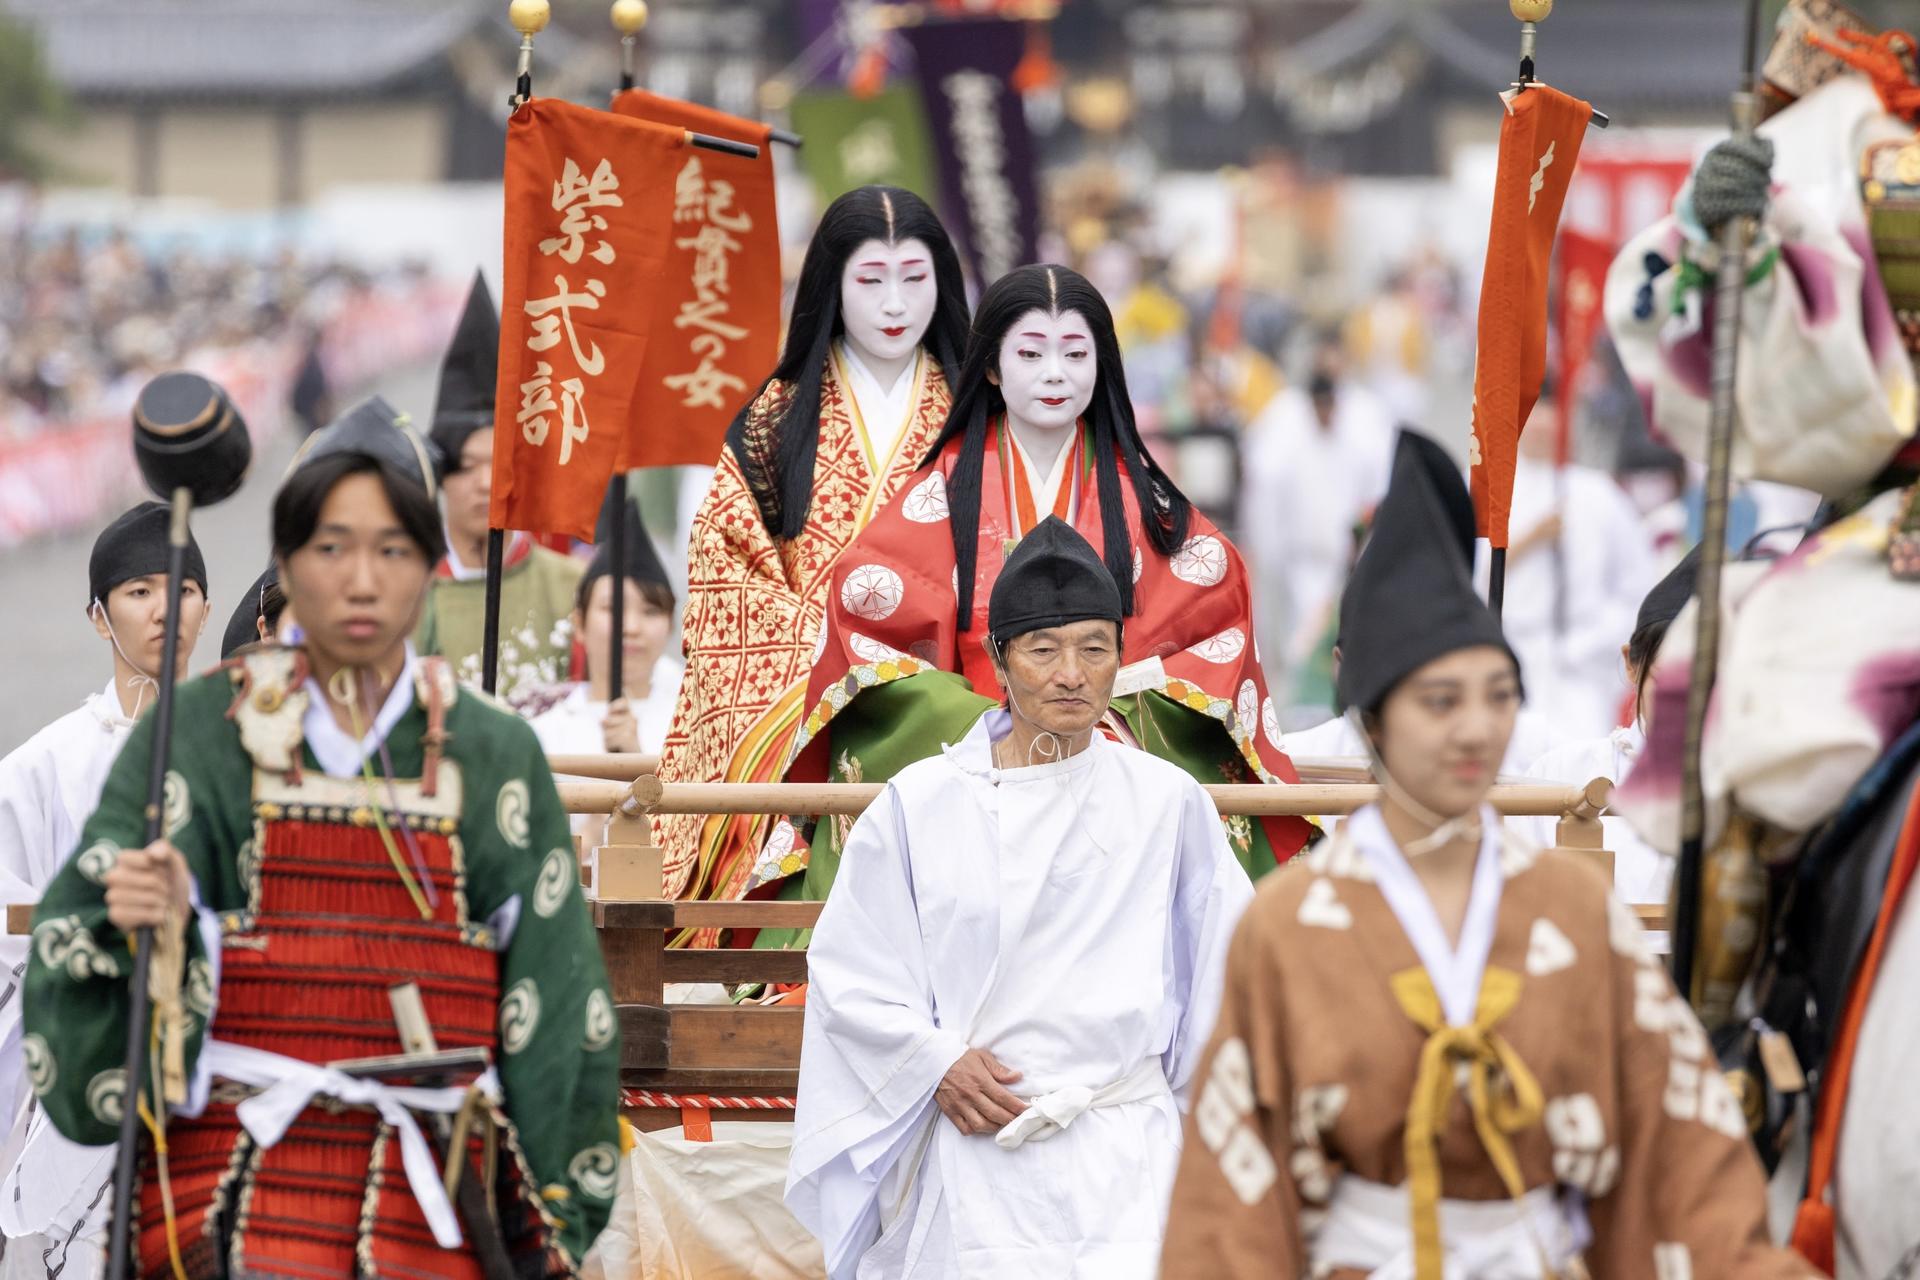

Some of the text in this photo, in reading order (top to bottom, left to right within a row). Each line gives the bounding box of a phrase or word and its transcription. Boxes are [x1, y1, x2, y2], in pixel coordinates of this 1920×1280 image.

[516, 157, 624, 466] 紫式部
[662, 154, 753, 410] 紀貫之の女
